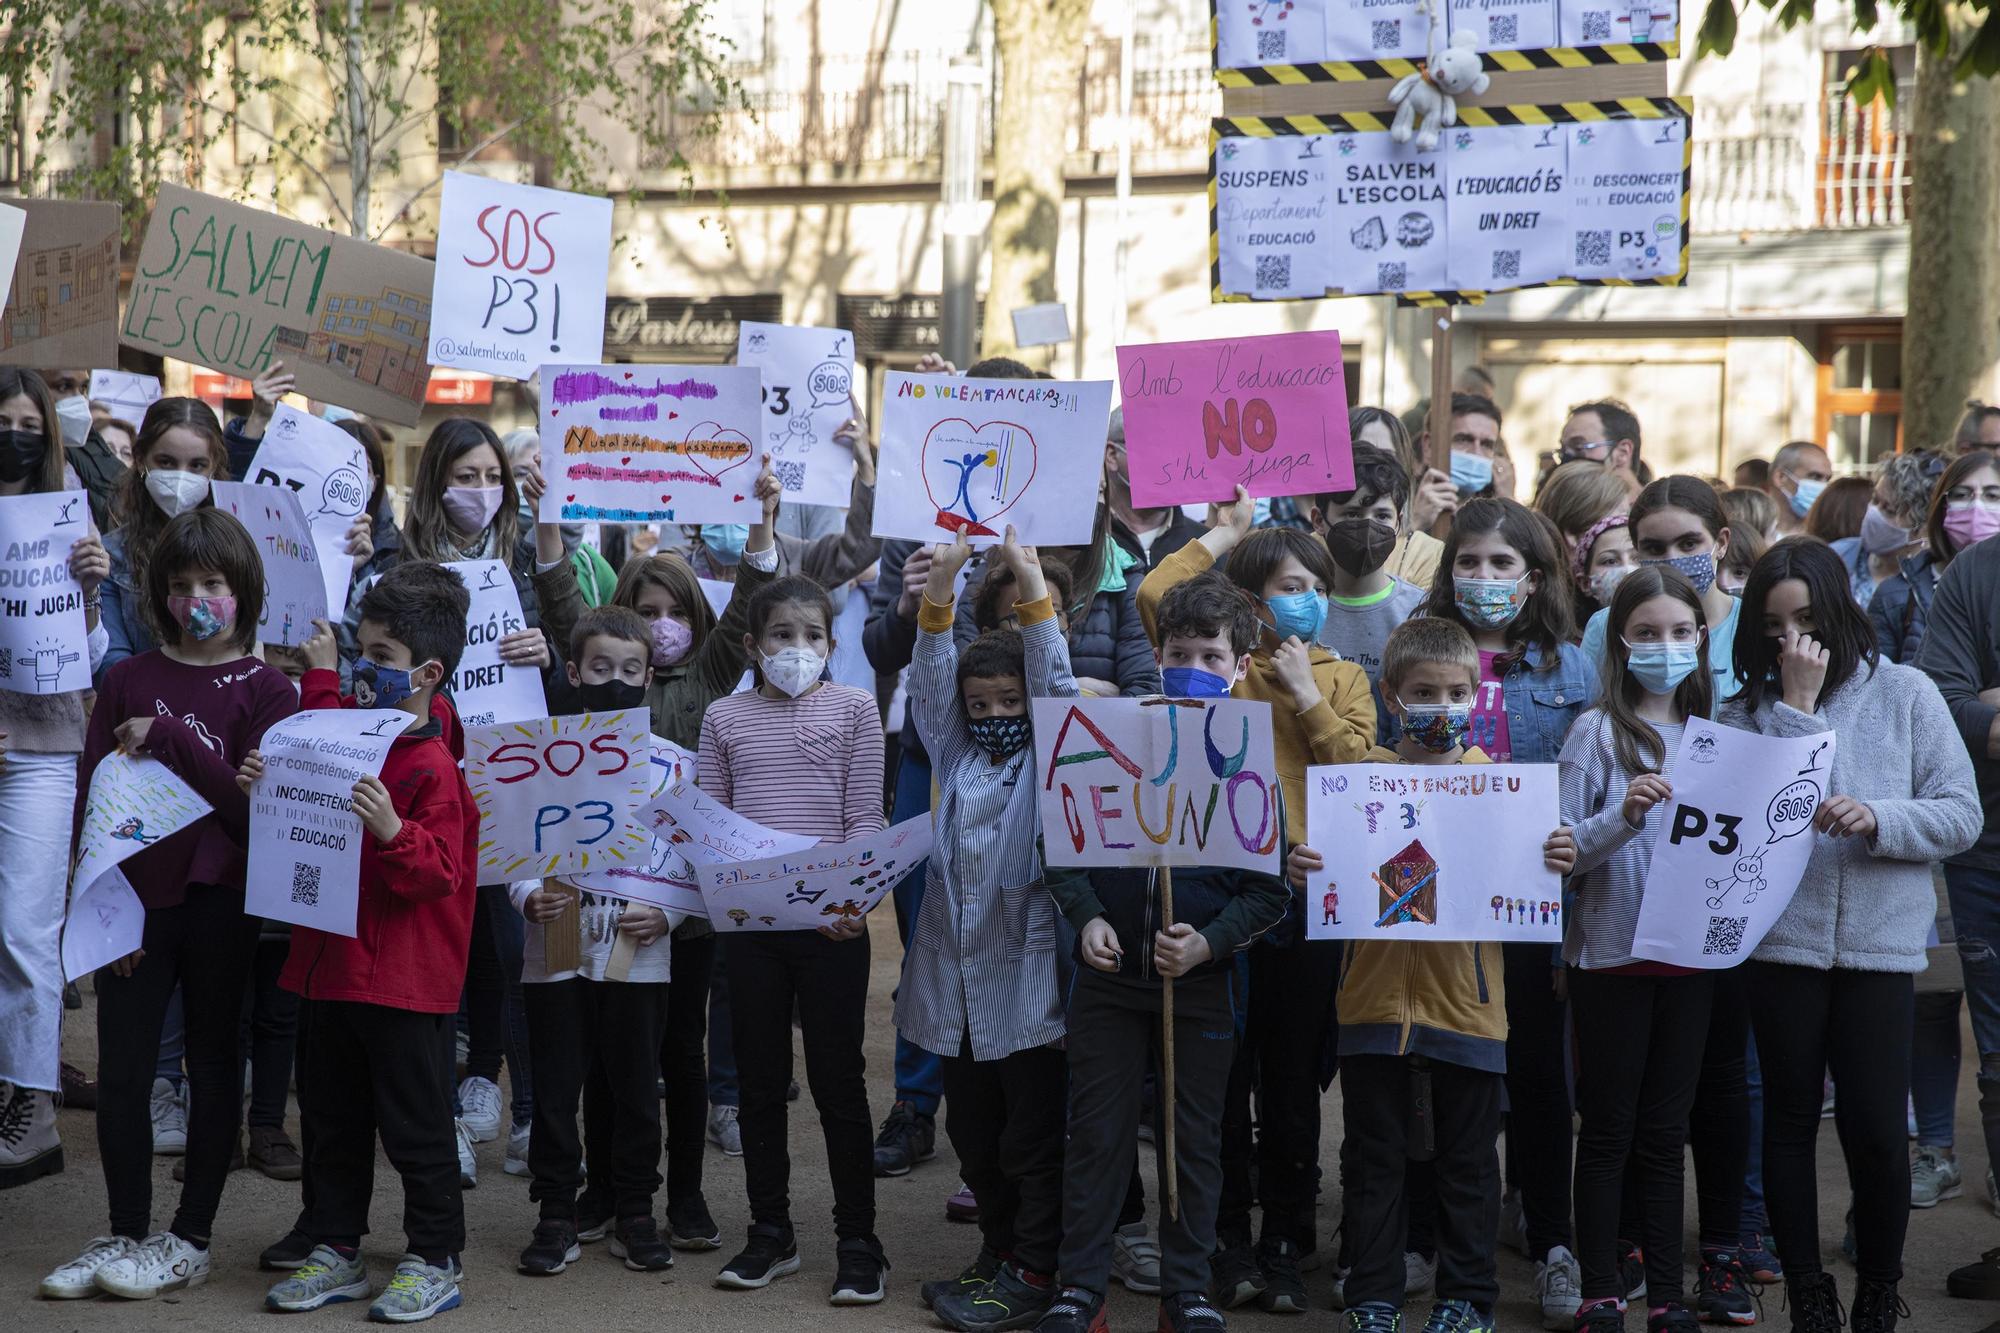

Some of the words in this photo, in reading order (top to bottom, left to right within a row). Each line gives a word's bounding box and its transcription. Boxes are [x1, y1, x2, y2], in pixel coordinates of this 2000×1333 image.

[1218, 169, 1309, 188] SUSPENS
[1346, 162, 1436, 182] SALVEM
[1456, 168, 1543, 195] L'EDUCACIÓ
[1544, 167, 1562, 192] ÉS
[1593, 172, 1680, 188] DESCONCERT
[1336, 184, 1446, 205] L'ESCOLA
[1608, 190, 1676, 206] EDUCACIÓ
[1479, 213, 1500, 231] UN
[1502, 211, 1540, 230] DRET
[463, 205, 561, 275] SOS
[1248, 229, 1316, 246] EDUCACIÓ
[1619, 231, 1645, 248] P3
[142, 206, 332, 316] SALVEM
[482, 275, 561, 353] P3!
[124, 284, 280, 373] L'ESCOLA
[435, 337, 527, 363] @salvemlescola
[814, 374, 848, 394] SOS
[1122, 357, 1183, 399] Amb
[1210, 343, 1340, 394] l'educació
[762, 386, 792, 416] 3
[898, 380, 926, 398] NO
[1202, 398, 1277, 459] NO
[1154, 452, 1208, 486] s'hi
[330, 478, 362, 508] SOS
[5, 540, 50, 561] AMB
[0, 563, 69, 588] DUCACI
[35, 591, 81, 617] JUGA!
[1360, 654, 1380, 666] The
[464, 663, 505, 692] DRET
[270, 732, 314, 750] Davant
[313, 737, 377, 762] l'educació
[487, 734, 629, 783] SOS
[1046, 699, 1249, 791] AJU
[275, 785, 357, 813] INCOMPETÈNC
[1321, 775, 1348, 797] NO
[256, 803, 279, 816] DEL
[286, 807, 361, 834] DEPARTAMENT
[1773, 795, 1816, 823] SOS
[289, 826, 346, 851] EDUCACIÓ
[535, 801, 614, 852] P3
[1669, 803, 1743, 856] P3
